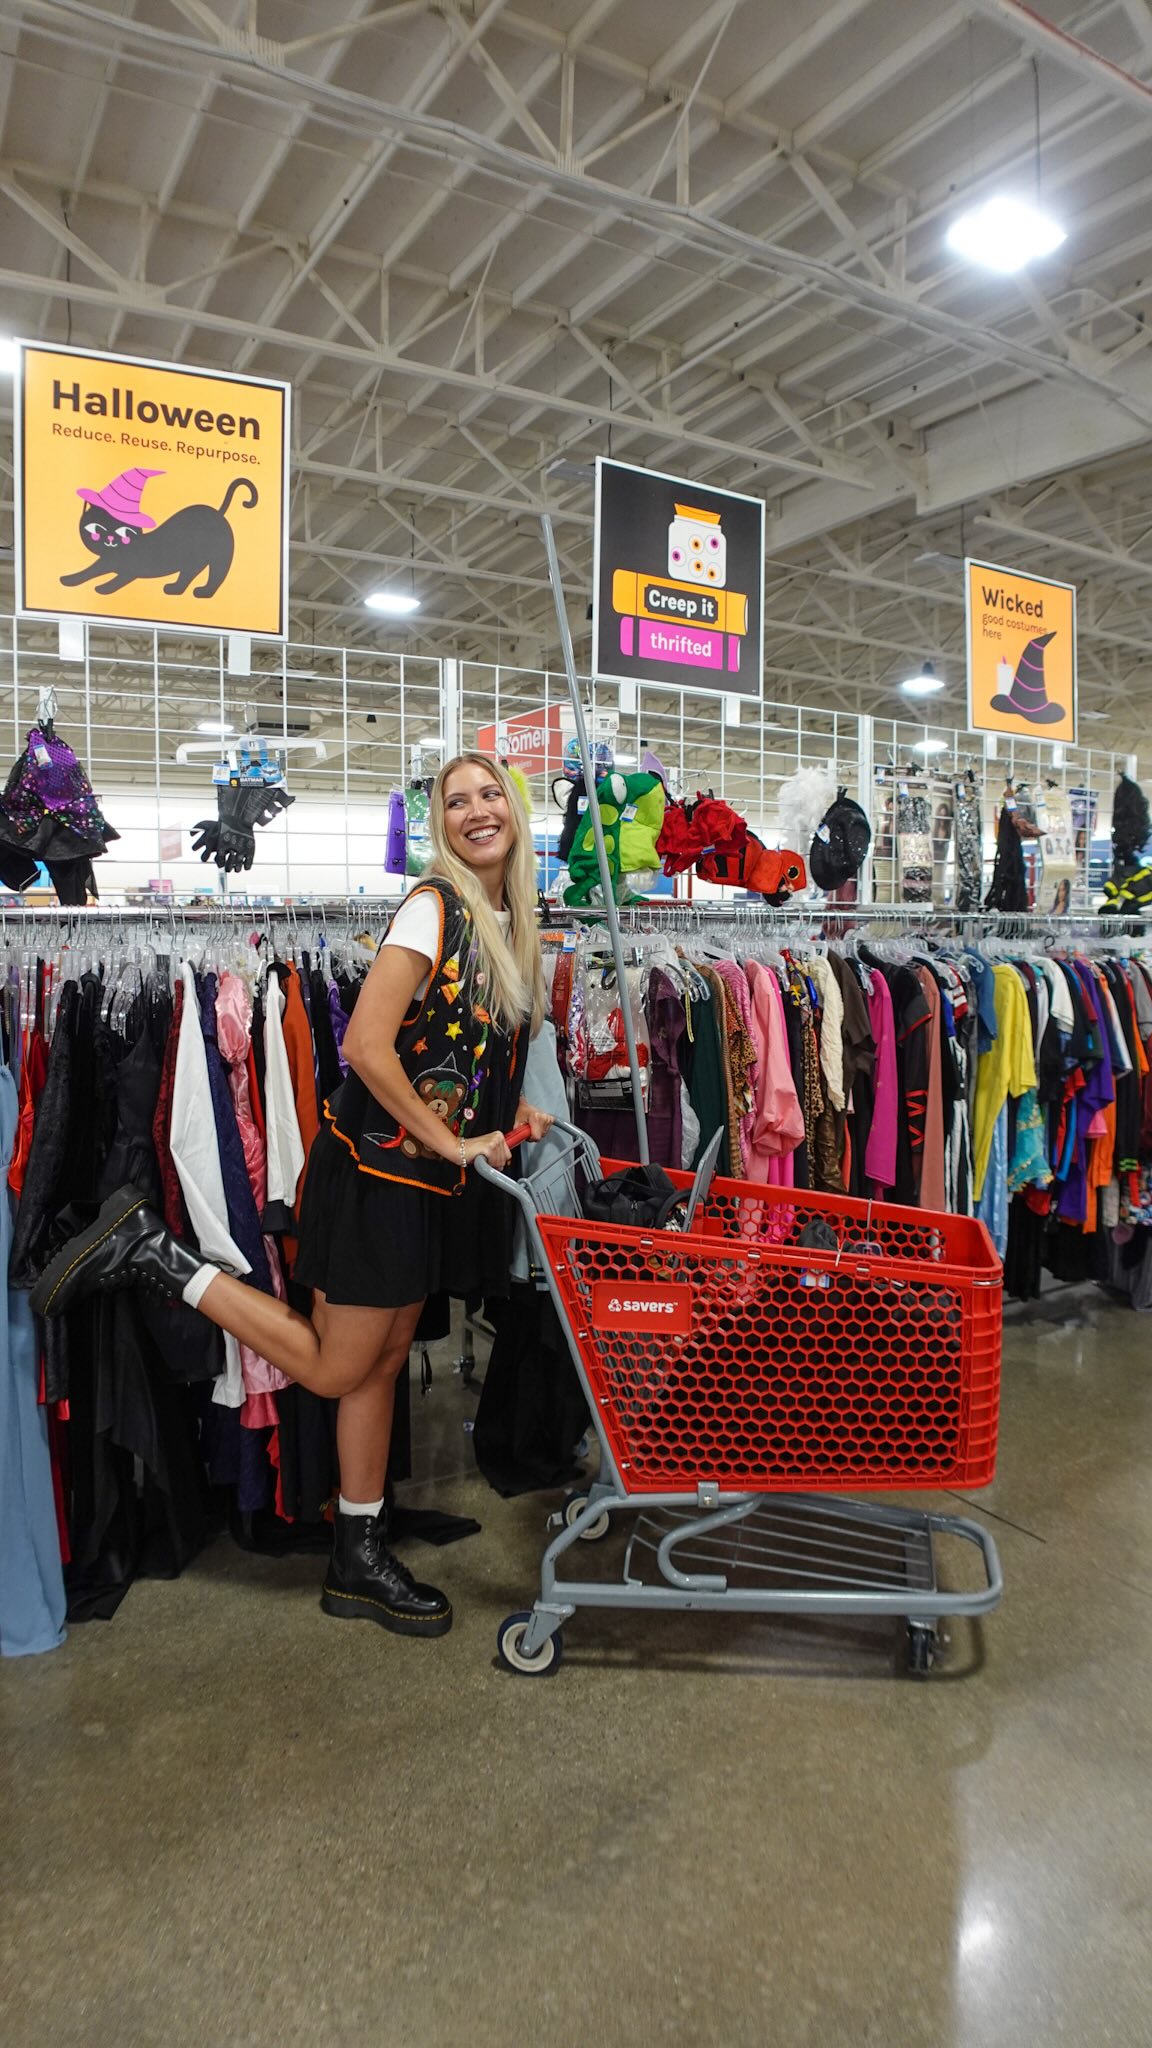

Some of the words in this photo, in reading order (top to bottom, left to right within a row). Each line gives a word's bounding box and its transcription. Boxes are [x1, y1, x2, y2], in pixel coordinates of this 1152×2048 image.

[52, 379, 261, 440] Halloween
[52, 423, 116, 443] Reduce.
[121, 433, 172, 451] Reuse.
[177, 441, 261, 465] Repurpose.
[649, 590, 697, 617] Creep
[702, 598, 714, 618] it
[982, 586, 1043, 618] Wicked
[982, 613, 1004, 626] good
[1006, 619, 1048, 634] costumes
[983, 626, 1002, 640] here
[650, 632, 712, 658] thrifted
[622, 1300, 674, 1314] savers
